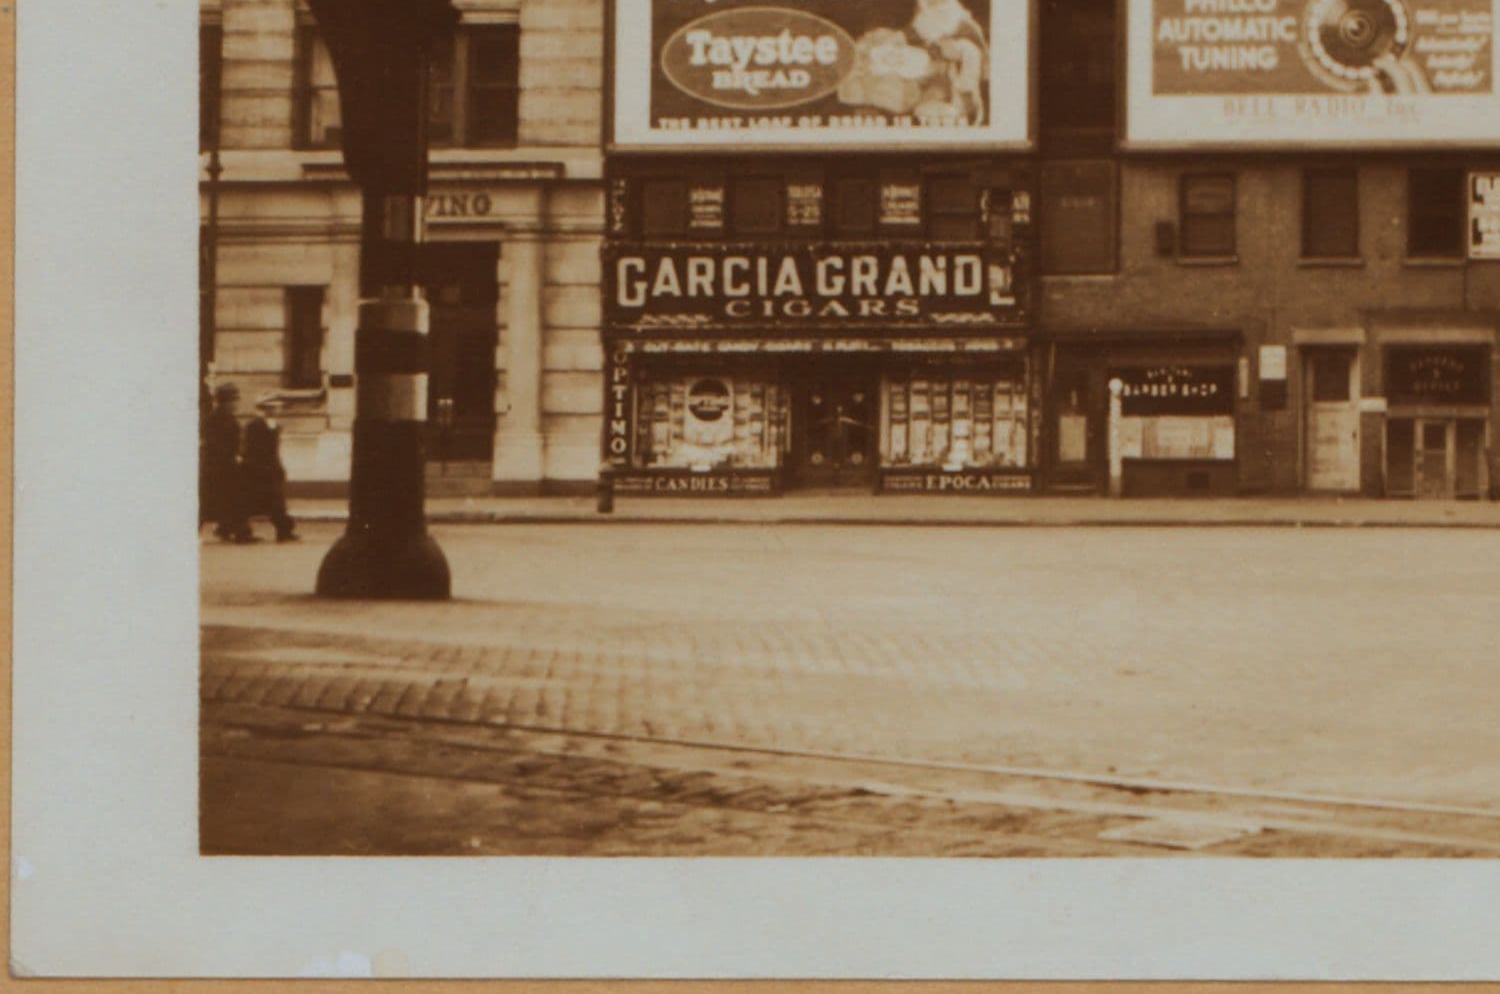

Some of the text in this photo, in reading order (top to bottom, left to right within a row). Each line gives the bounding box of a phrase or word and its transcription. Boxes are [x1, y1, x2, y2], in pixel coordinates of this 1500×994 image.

[1157, 16, 1298, 43] AUTOMATIC
[685, 29, 840, 75] Taystee
[1177, 45, 1279, 71] TUNING
[712, 70, 812, 96] BREAD
[617, 254, 982, 307] GARCIA GRAND
[725, 299, 920, 317] CIGARS
[655, 476, 729, 492] CANDIES
